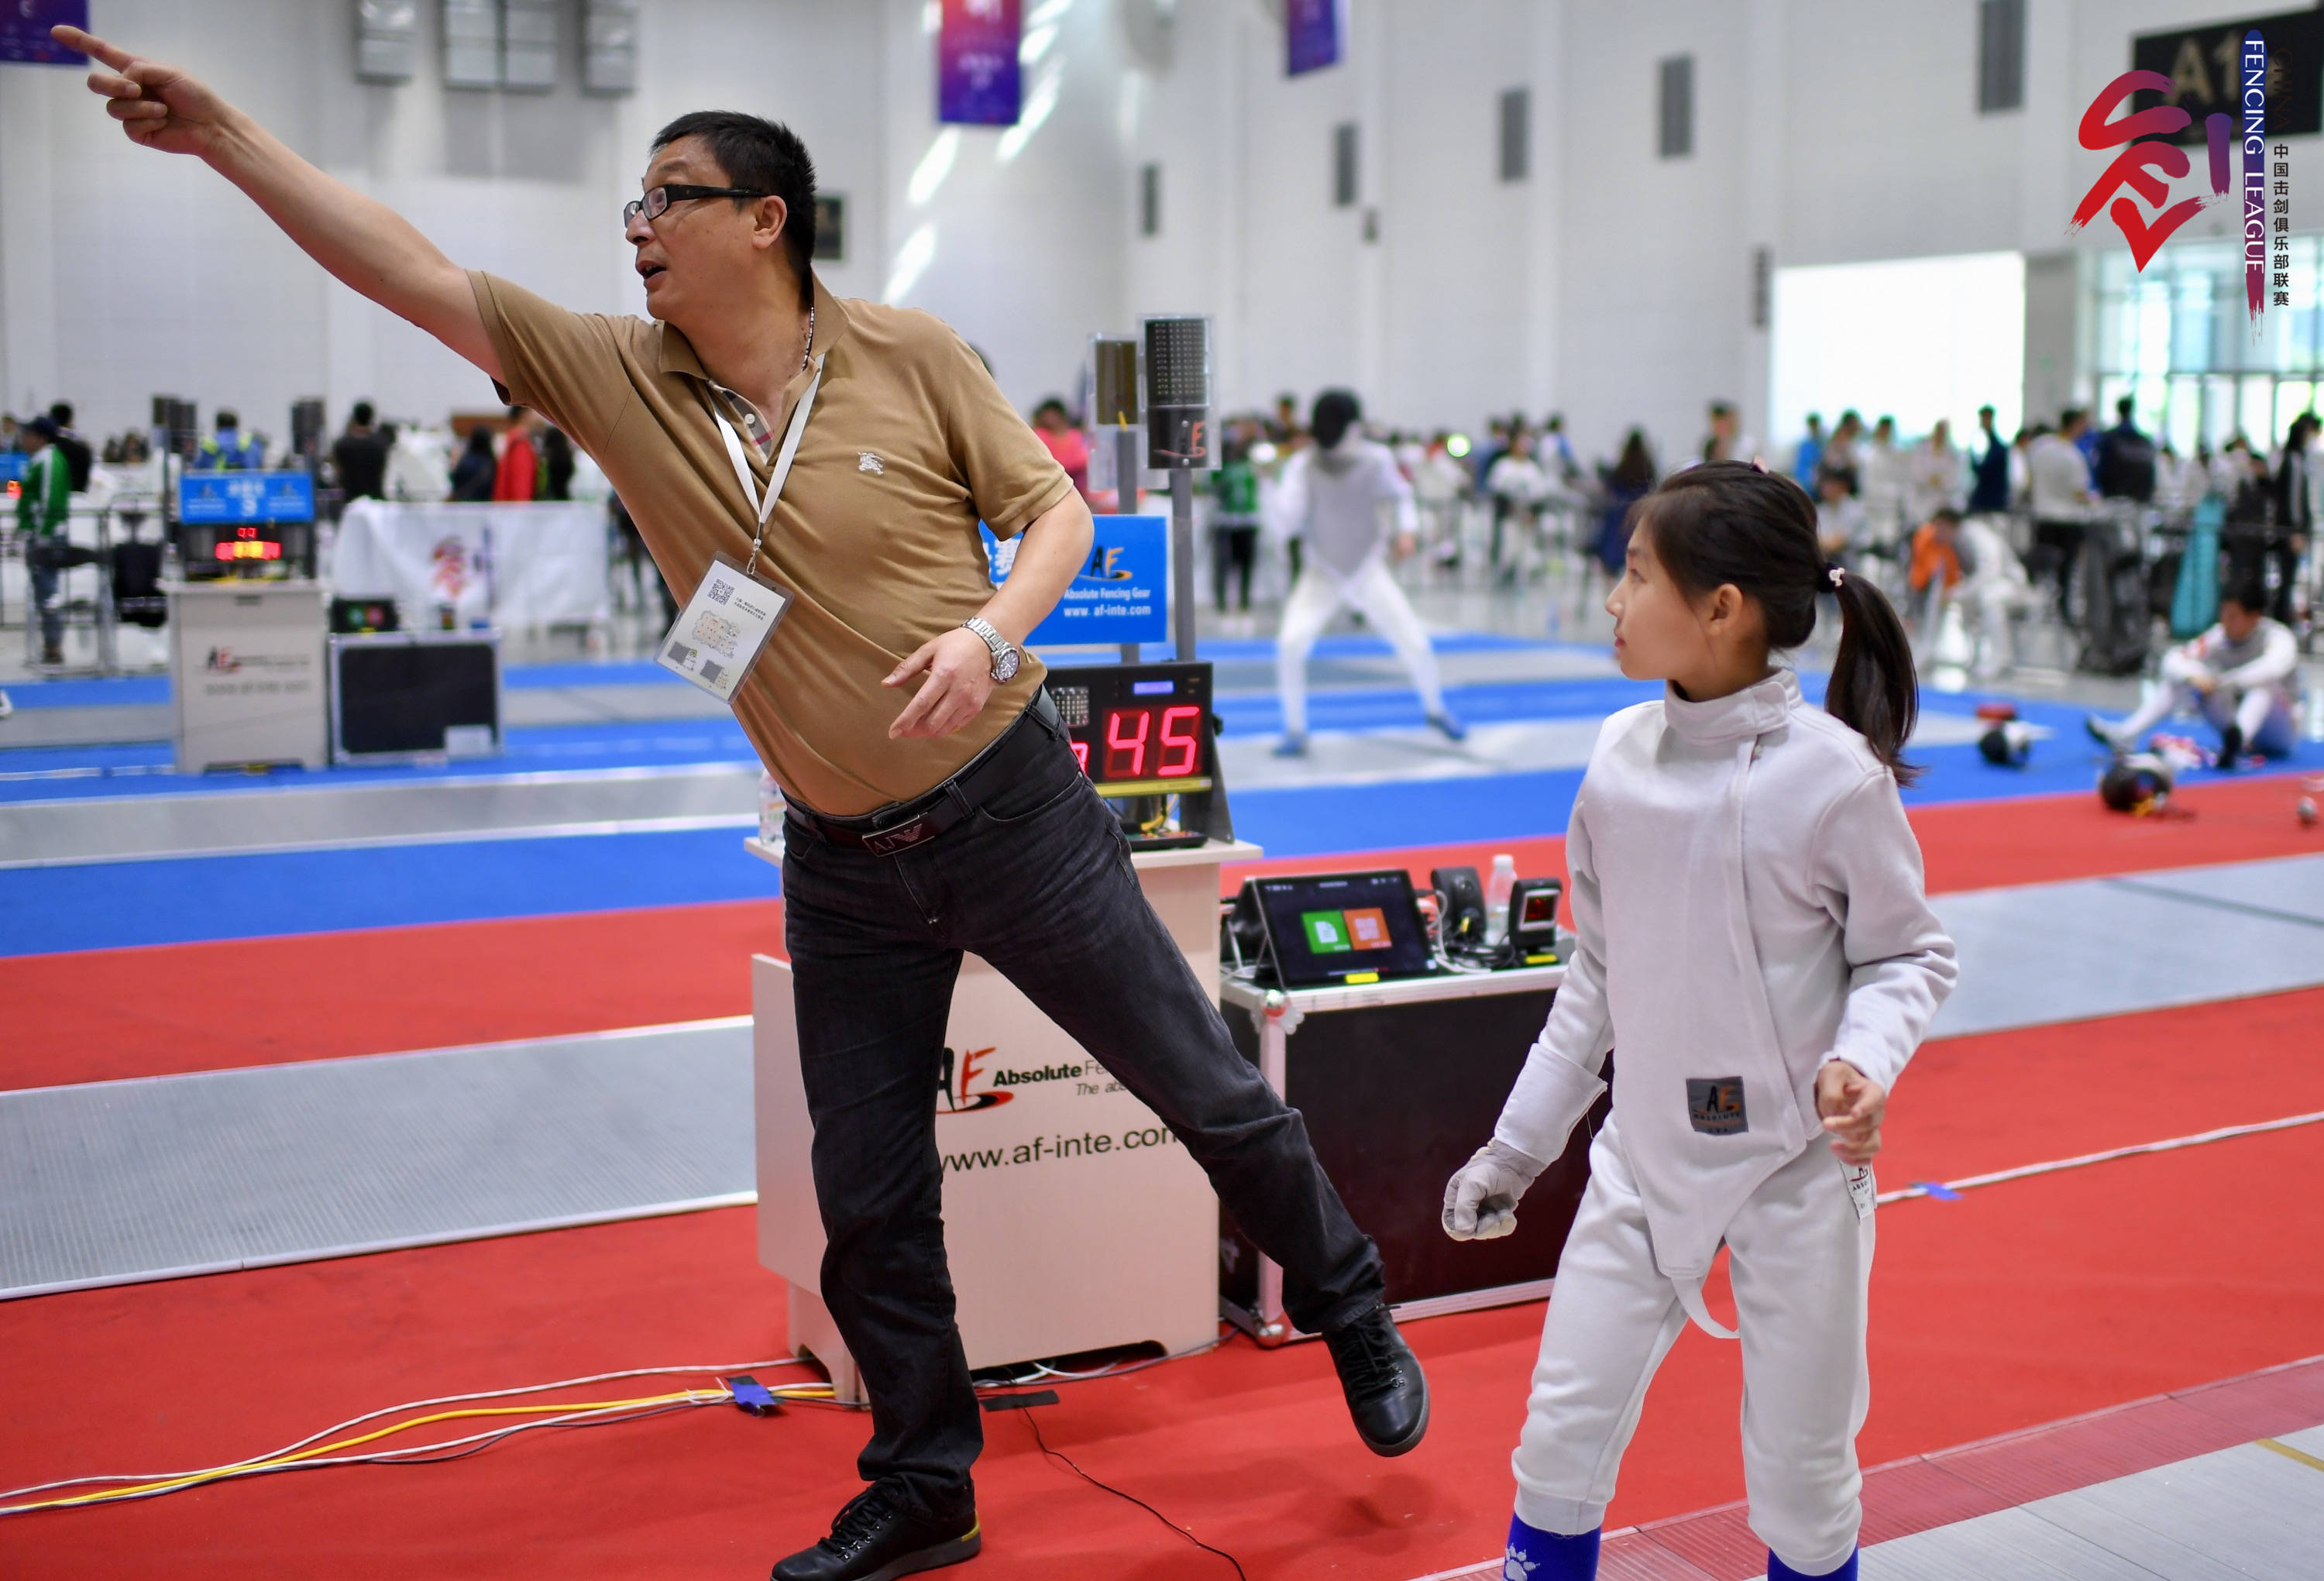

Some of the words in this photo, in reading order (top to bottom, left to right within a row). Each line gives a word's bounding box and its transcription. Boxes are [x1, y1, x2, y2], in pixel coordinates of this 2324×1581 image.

[1064, 588, 1098, 600] Absolute
[1101, 587, 1130, 602] Fencing
[1132, 587, 1151, 599] Gear
[1094, 604, 1152, 617] af-inte.com
[1108, 706, 1200, 775] 45
[993, 1064, 1082, 1088] Absolute
[1077, 1083, 1099, 1095] The
